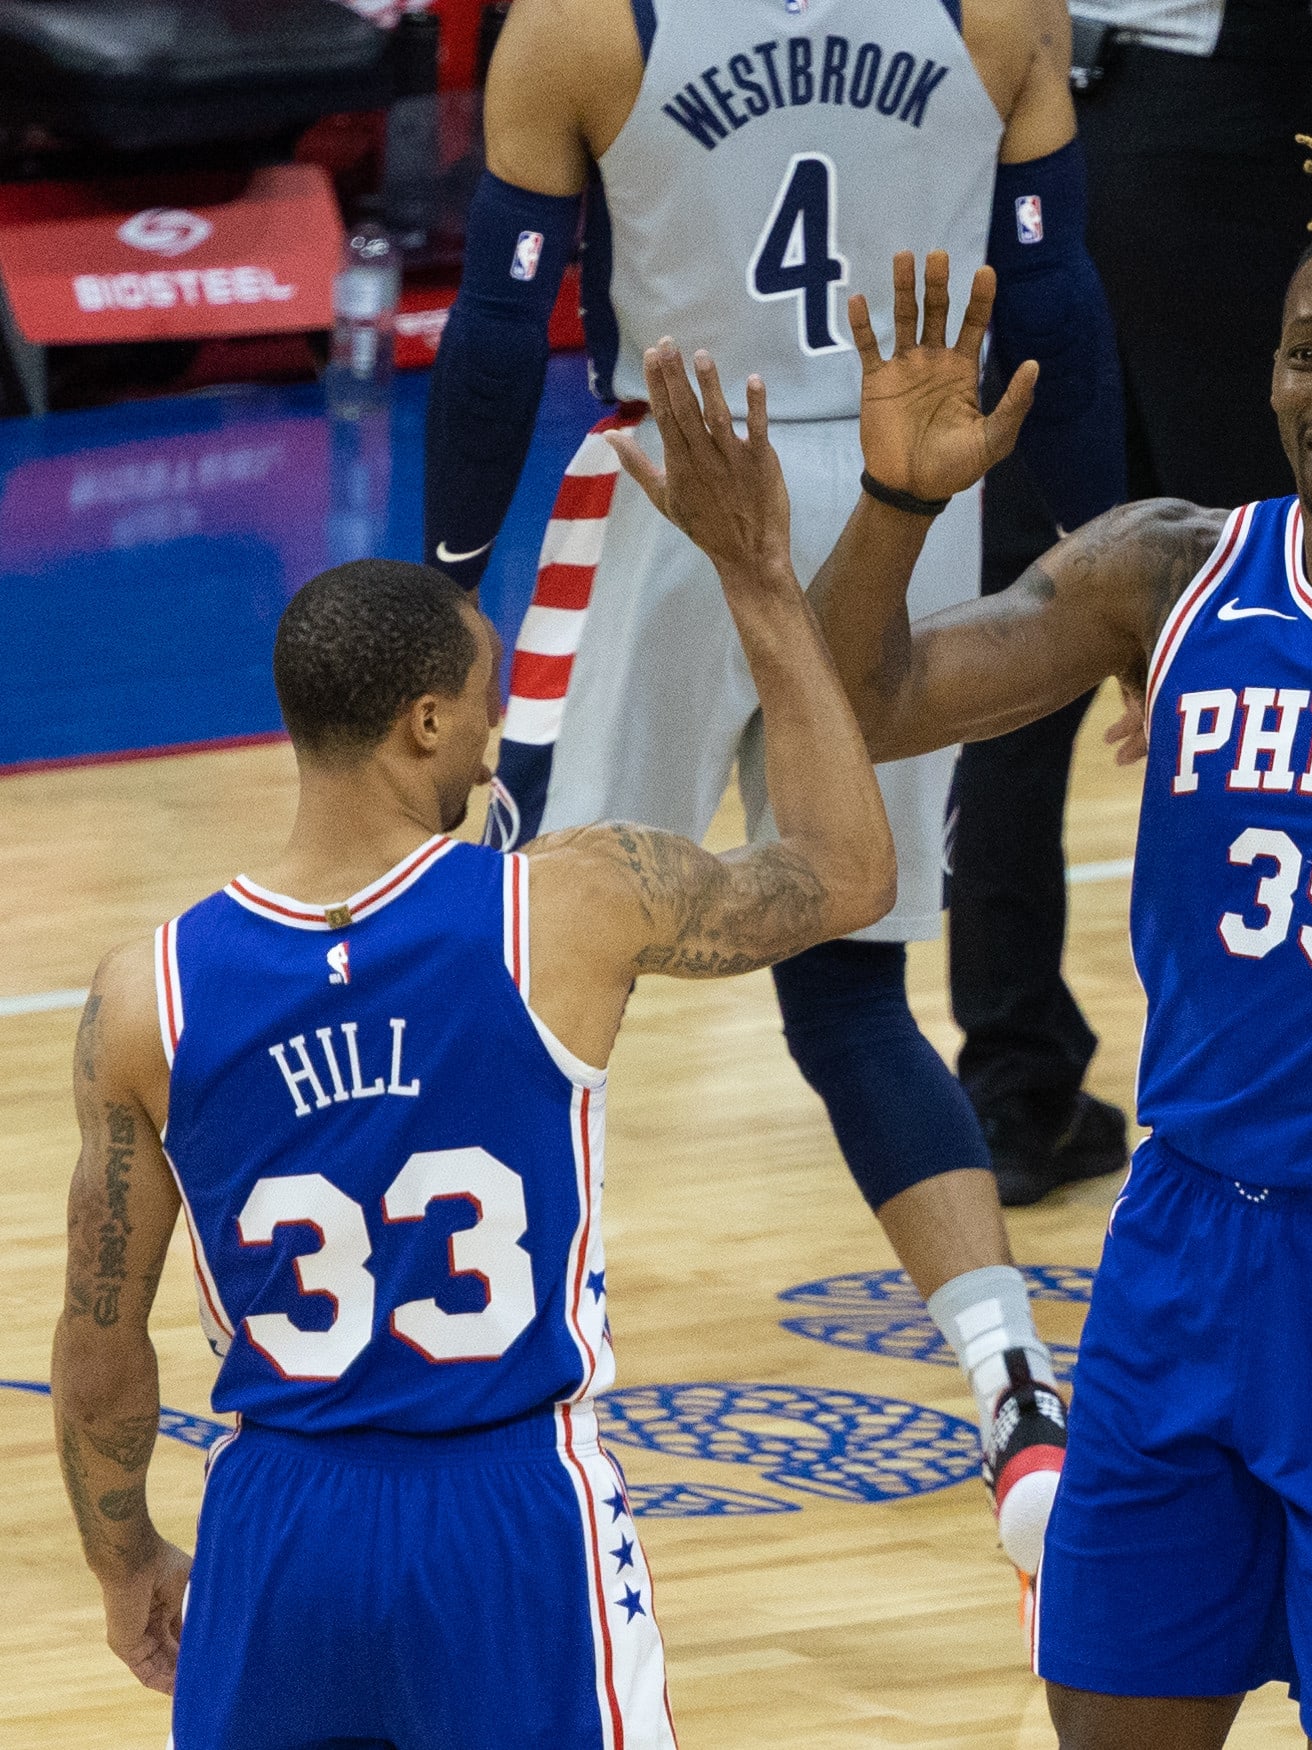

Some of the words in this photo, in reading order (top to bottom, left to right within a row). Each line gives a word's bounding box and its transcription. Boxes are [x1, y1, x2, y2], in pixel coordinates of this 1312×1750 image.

[661, 34, 950, 151] WESTBROOK
[746, 151, 853, 356] 4
[268, 1018, 421, 1117] HILL
[236, 1146, 537, 1383] 33
